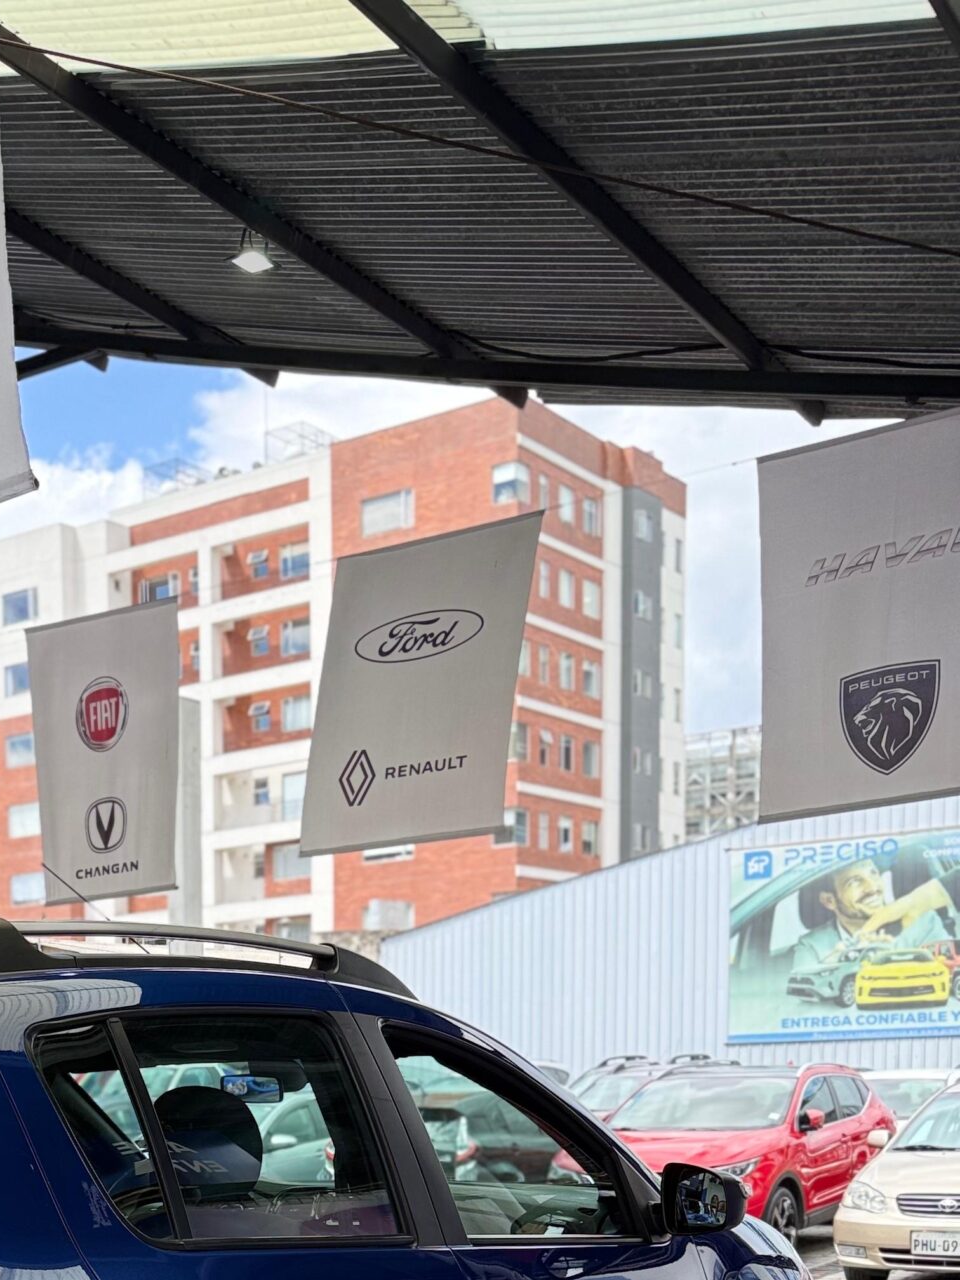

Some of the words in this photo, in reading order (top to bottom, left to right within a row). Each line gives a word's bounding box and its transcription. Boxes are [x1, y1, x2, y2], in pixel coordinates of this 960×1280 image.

[377, 616, 460, 658] Ford
[848, 669, 931, 694] PEUGEOT
[89, 695, 117, 732] FIAT
[384, 754, 468, 780] RENAULT
[784, 838, 899, 866] PRECISO
[75, 859, 140, 880] CHANGAN
[781, 1016, 852, 1029] ENTREGA
[855, 1011, 948, 1026] CONFIABLE
